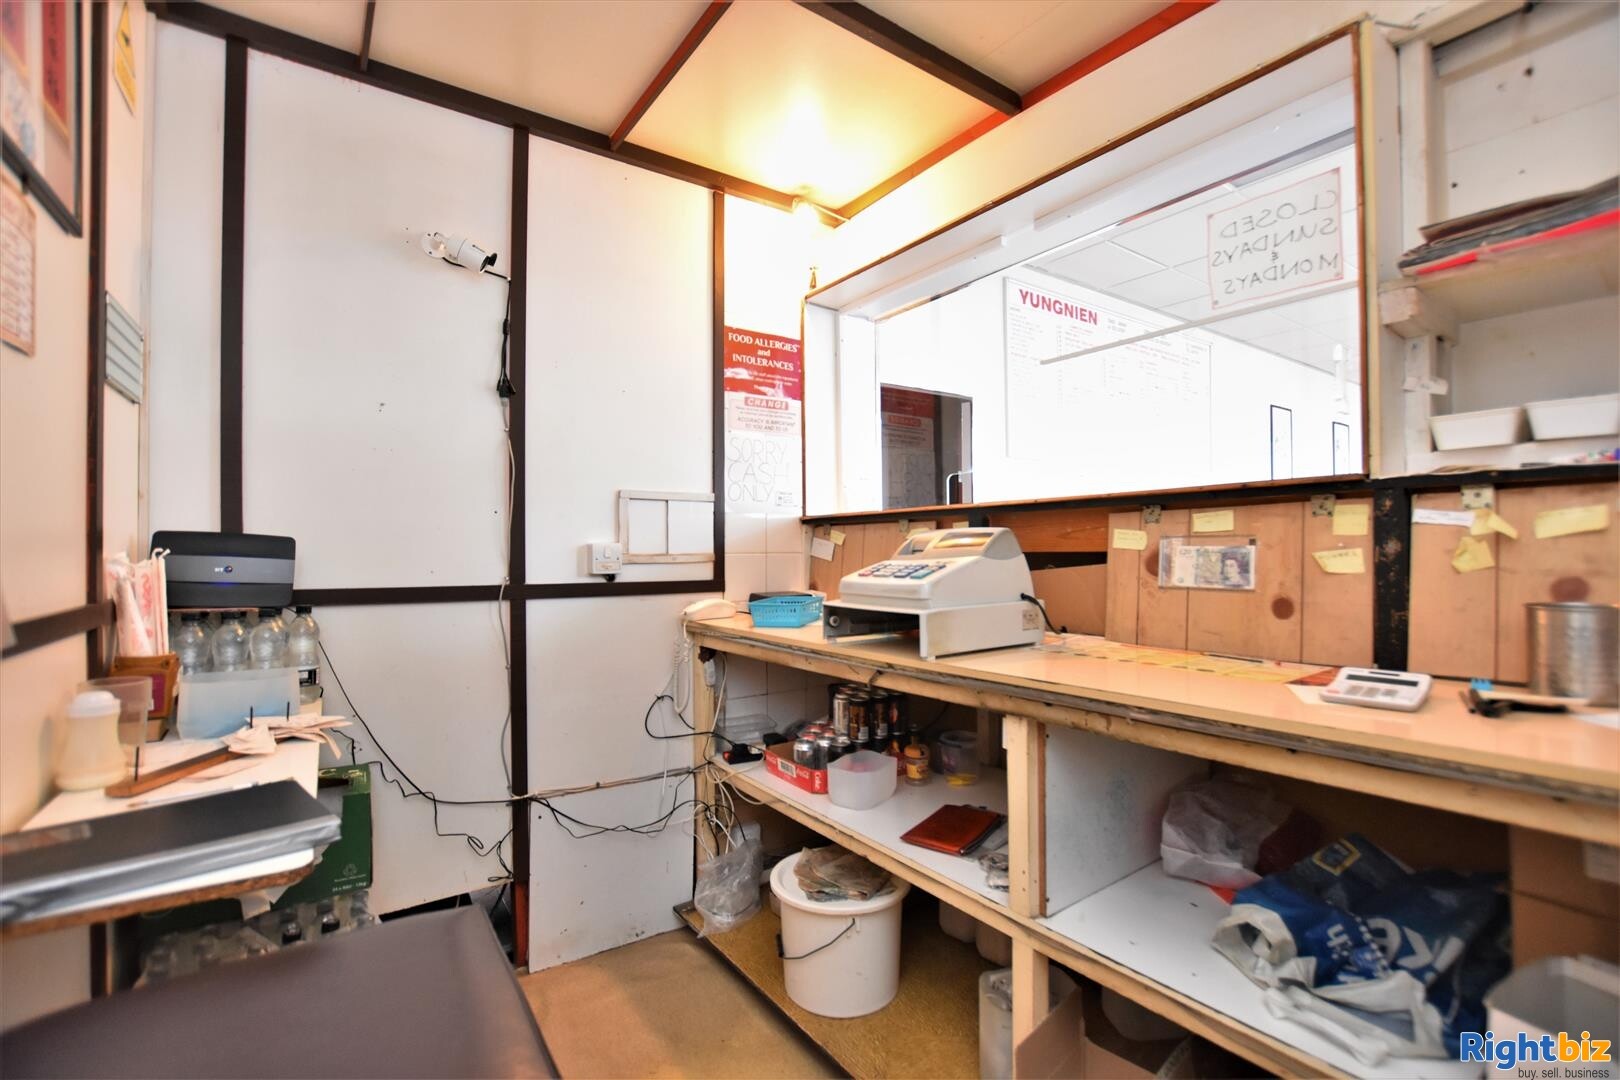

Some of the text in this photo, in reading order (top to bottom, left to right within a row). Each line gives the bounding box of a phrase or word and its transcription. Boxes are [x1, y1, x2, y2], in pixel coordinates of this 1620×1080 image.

[1019, 289, 1097, 325] YUNGNIEN
[728, 332, 798, 353] FOOD ALLERGIES
[757, 349, 771, 357] and
[732, 353, 794, 371] INTOLERANCES
[746, 398, 787, 410] CHANGE
[727, 436, 787, 464] SORRY
[727, 461, 791, 485] CASH
[727, 481, 774, 502] ONLY
